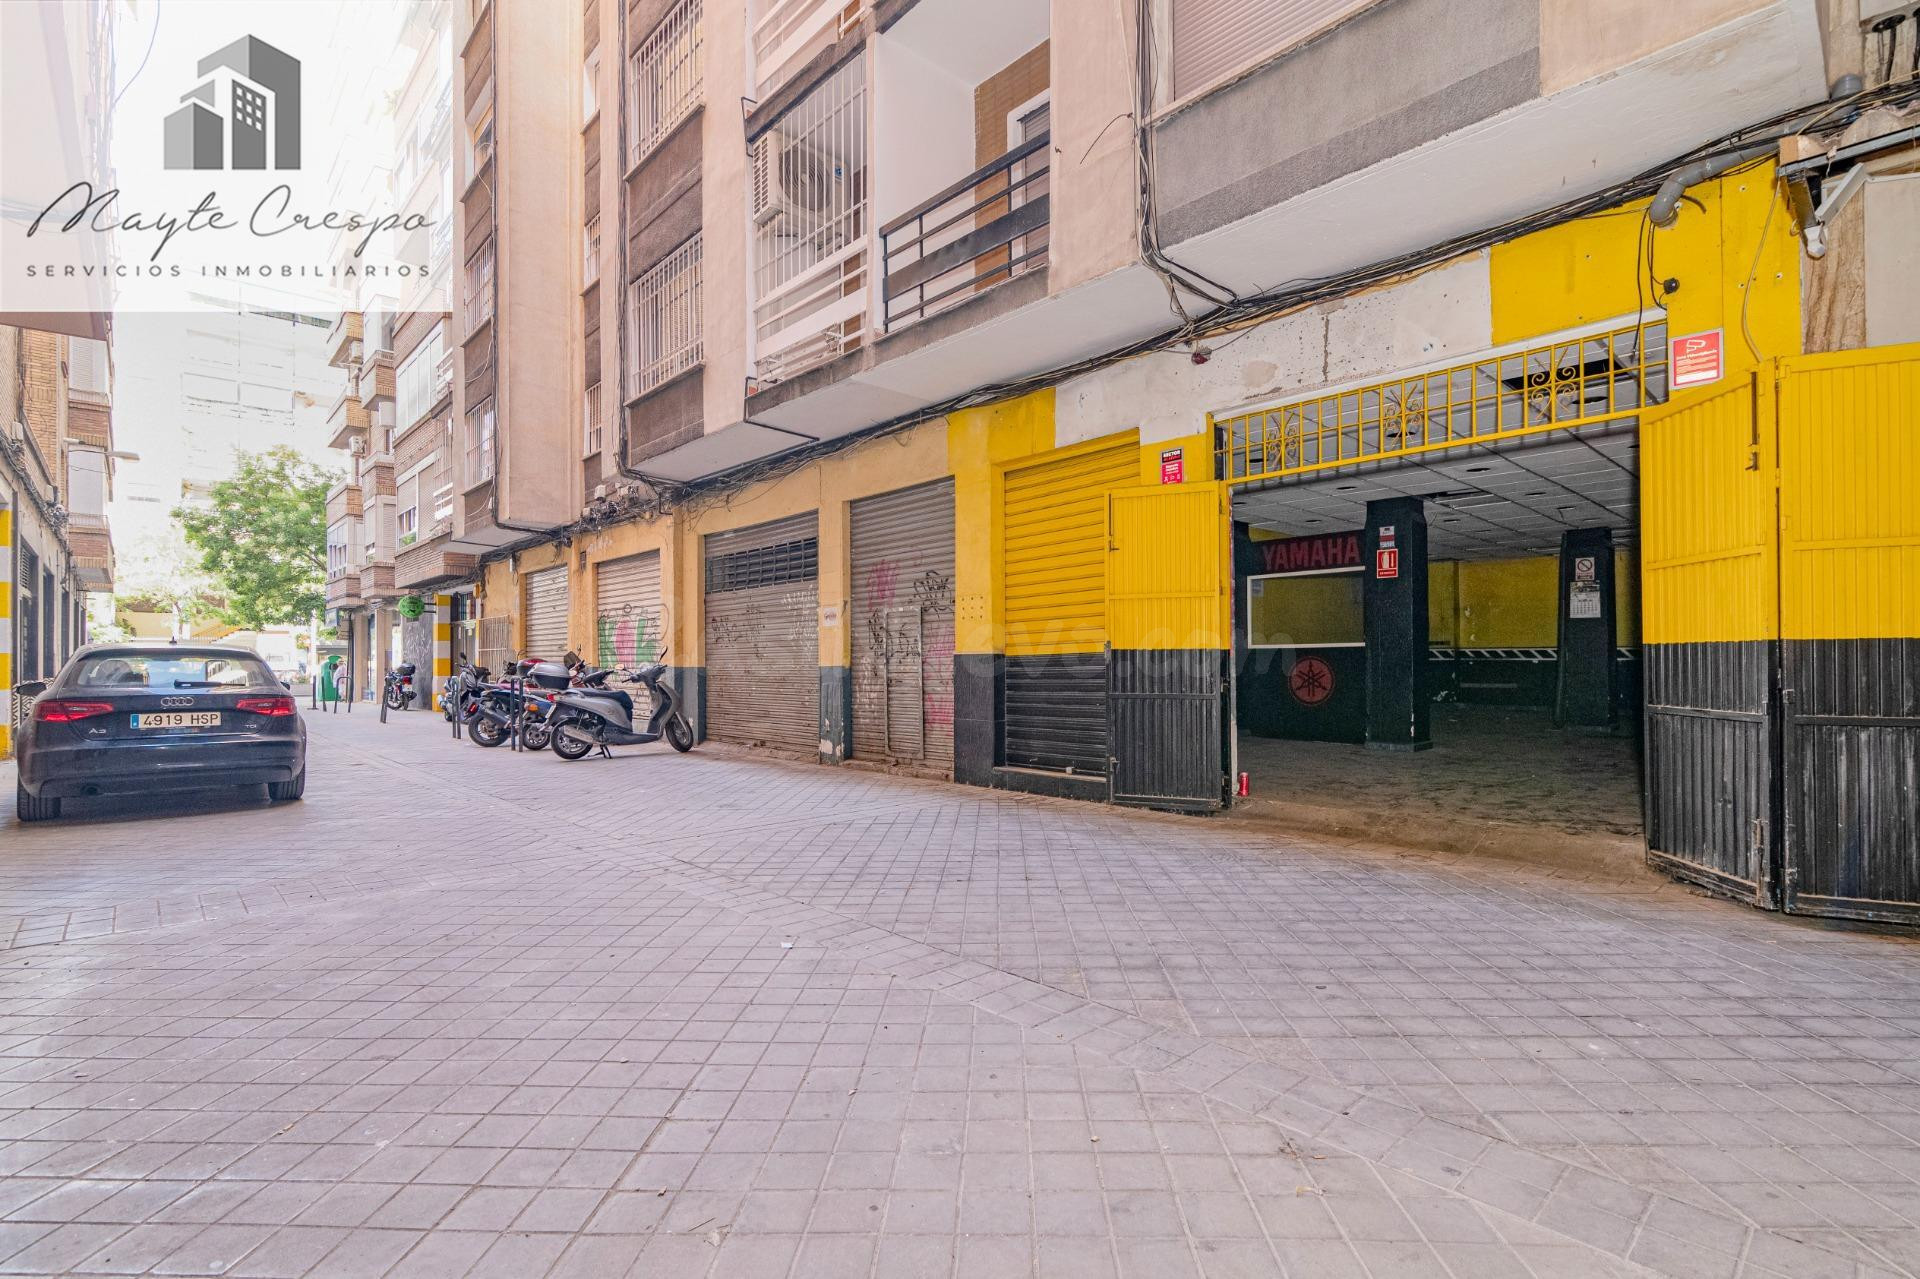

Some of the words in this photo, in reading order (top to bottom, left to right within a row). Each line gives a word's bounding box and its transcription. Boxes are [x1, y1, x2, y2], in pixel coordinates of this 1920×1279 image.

[1262, 534, 1361, 572] YAMAHA
[143, 715, 183, 726] 4919
[190, 713, 219, 725] HSP
